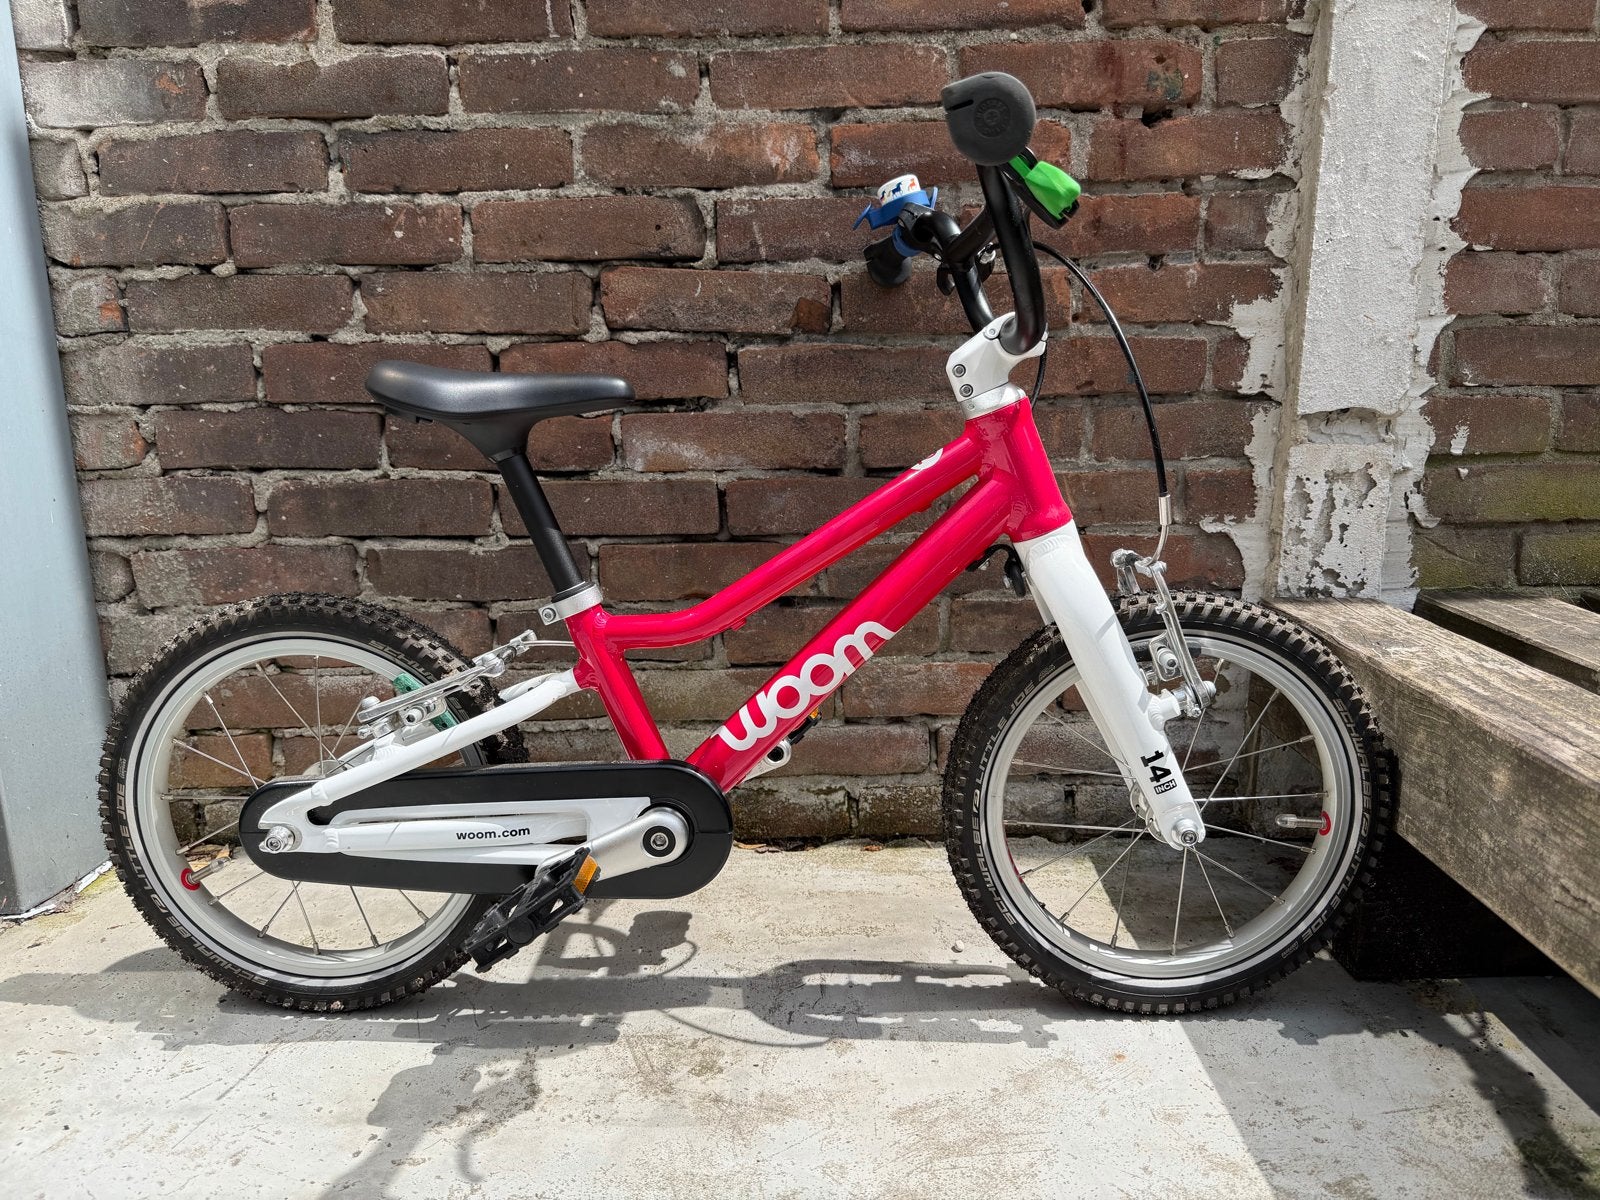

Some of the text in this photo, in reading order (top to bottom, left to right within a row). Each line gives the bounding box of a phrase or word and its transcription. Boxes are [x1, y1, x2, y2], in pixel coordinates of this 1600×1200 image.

[710, 621, 904, 751] woom
[971, 681, 1035, 926] SCHWALBE LITTLE JOE
[1140, 750, 1172, 783] 14
[1154, 779, 1177, 795] INCH
[1301, 698, 1371, 943] SCHWALBE LITTLE JOE
[116, 783, 269, 985] SCHWALBE LITTLE JOE
[456, 827, 531, 840] woom.com
